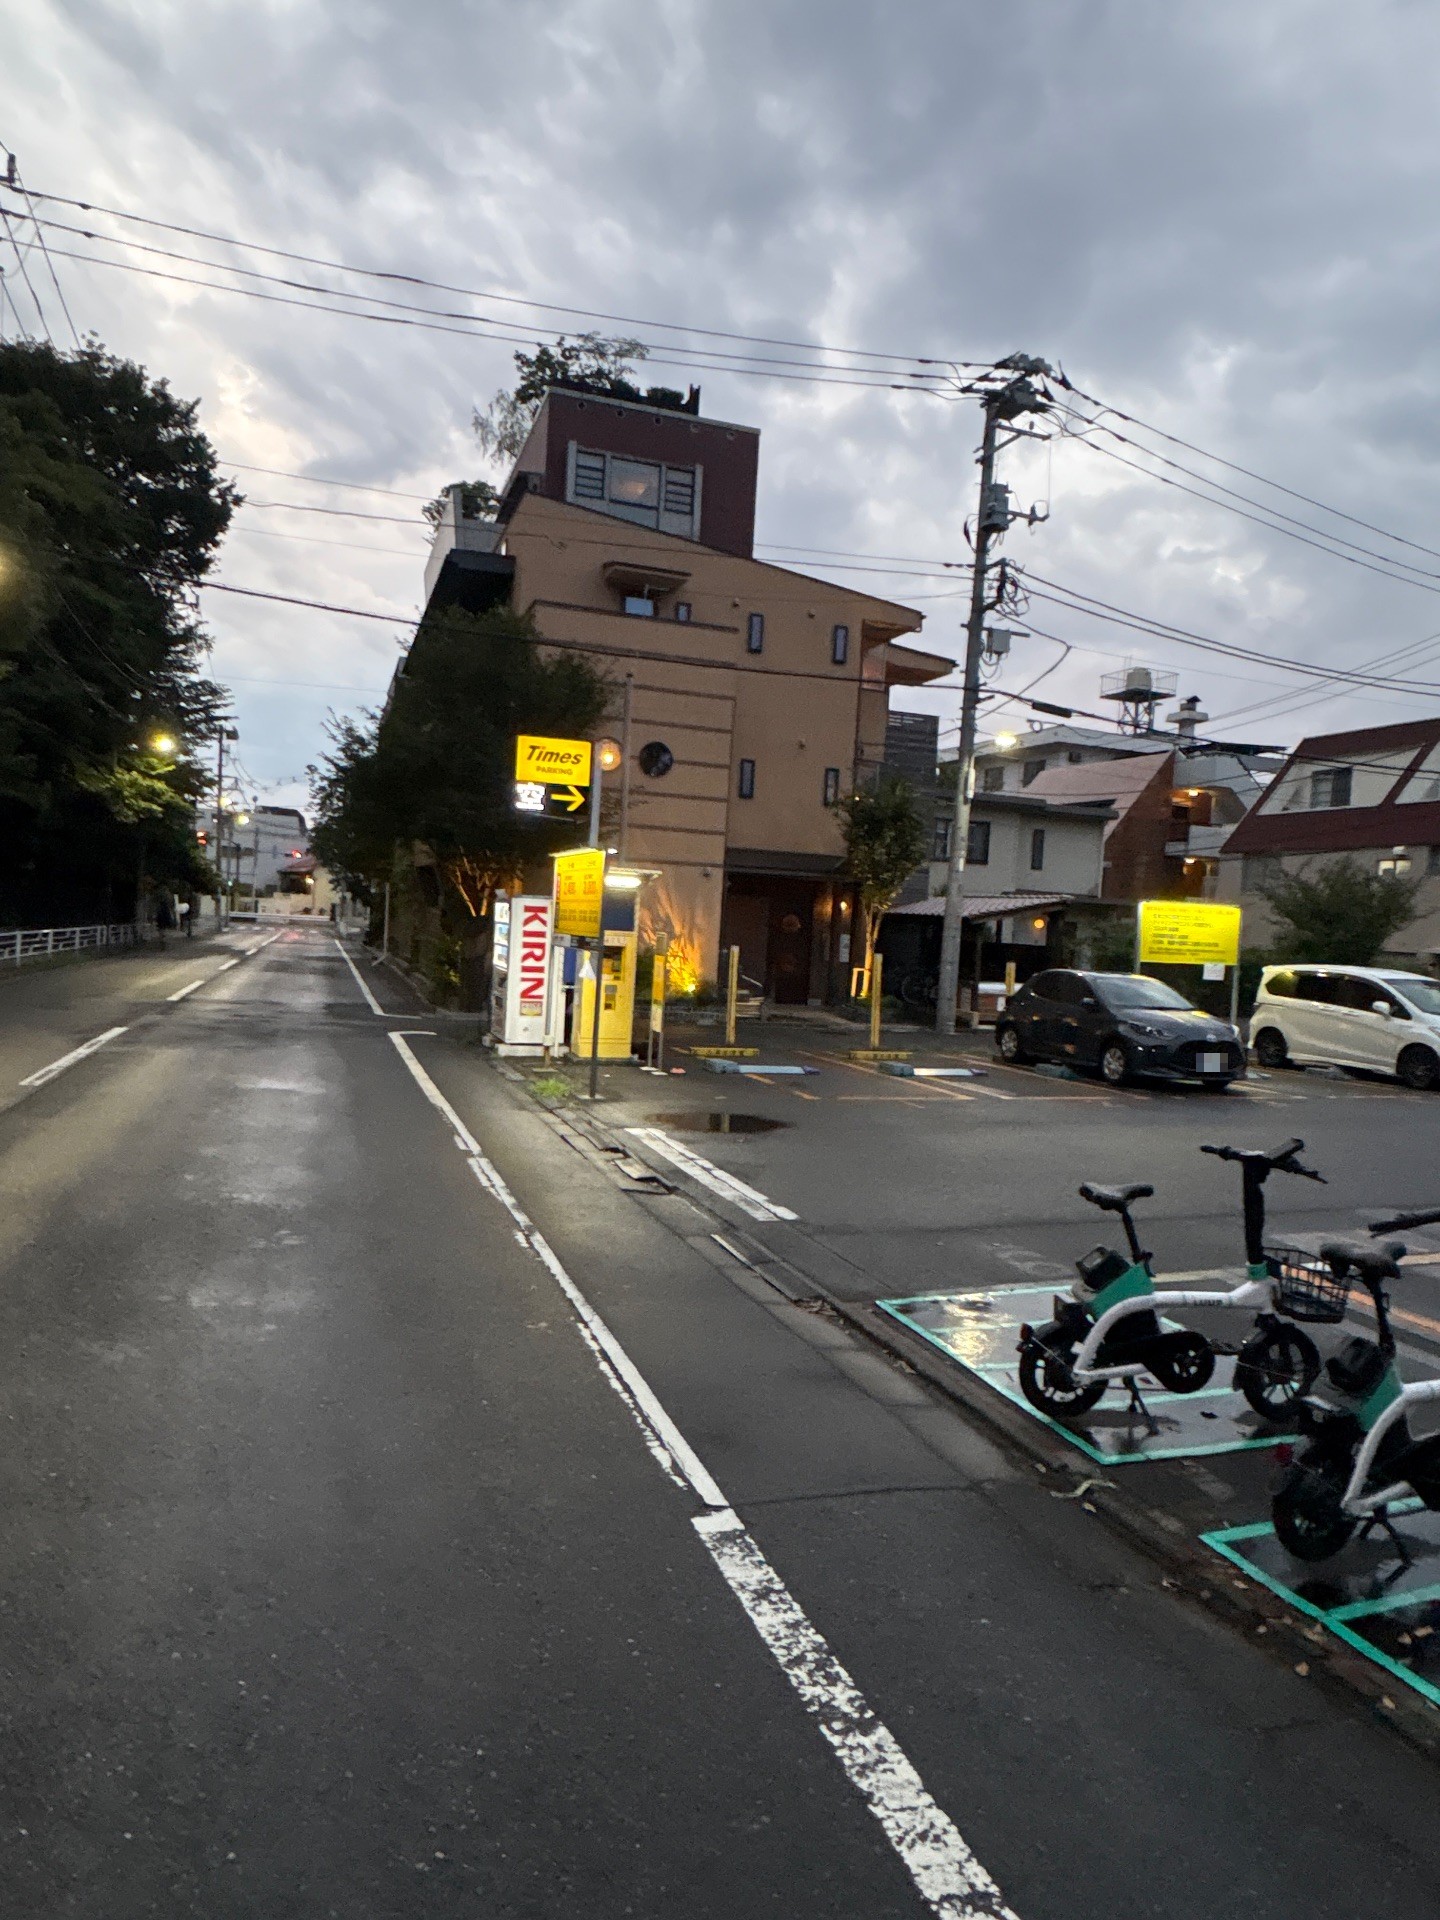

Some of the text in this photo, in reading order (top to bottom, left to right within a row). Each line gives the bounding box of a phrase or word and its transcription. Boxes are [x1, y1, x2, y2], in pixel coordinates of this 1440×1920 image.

[527, 745, 583, 765] Times
[536, 766, 573, 775] PARKING
[520, 905, 548, 1000] KIRIN
